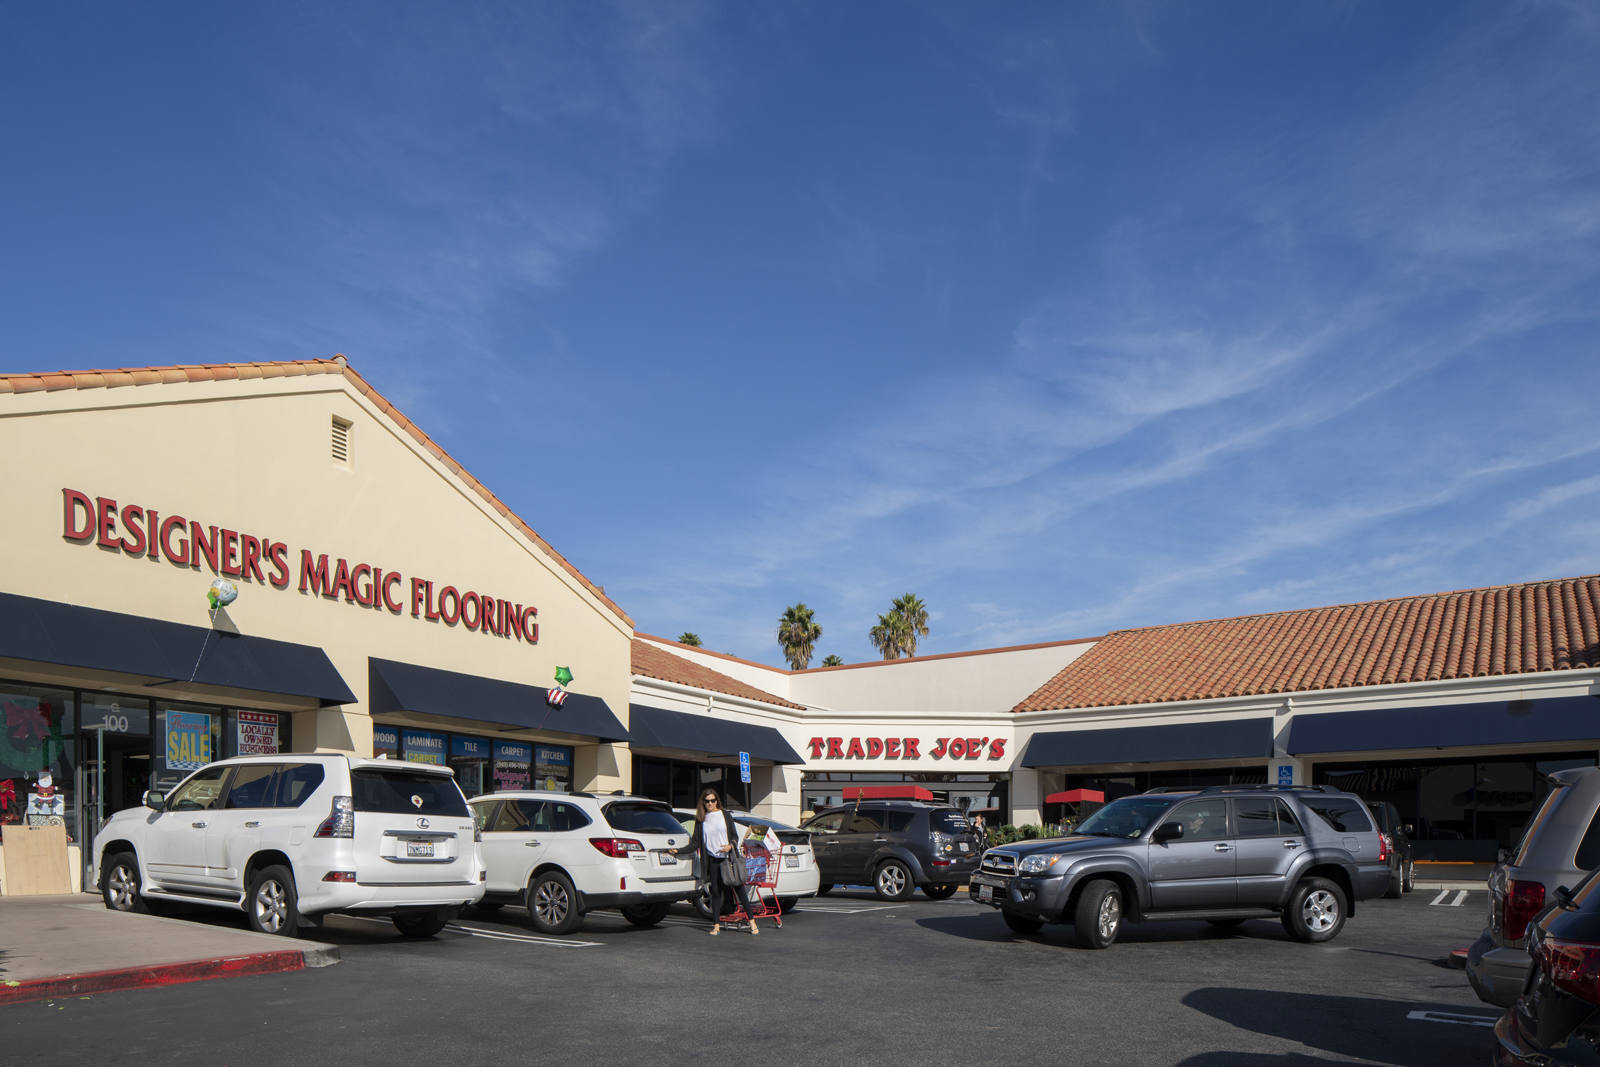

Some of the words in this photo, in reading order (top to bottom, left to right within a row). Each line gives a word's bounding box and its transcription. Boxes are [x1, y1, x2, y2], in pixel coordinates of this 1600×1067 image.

[62, 487, 290, 588] DESIGNER'S
[298, 549, 403, 613] MAGIC
[410, 577, 540, 643] FLOORING
[102, 714, 129, 732] 100
[240, 724, 276, 737] LOCALLY
[243, 734, 273, 745] OWNED
[407, 735, 443, 749] LAMINATE
[168, 731, 210, 763] SALE
[240, 743, 278, 754] BUSINESS
[463, 741, 478, 752] TILE
[501, 745, 524, 757] CARPET
[807, 737, 921, 760] TRADER
[929, 736, 1008, 761] JOE'S
[408, 752, 438, 765] CARPET
[541, 750, 565, 761] KITCHEN
